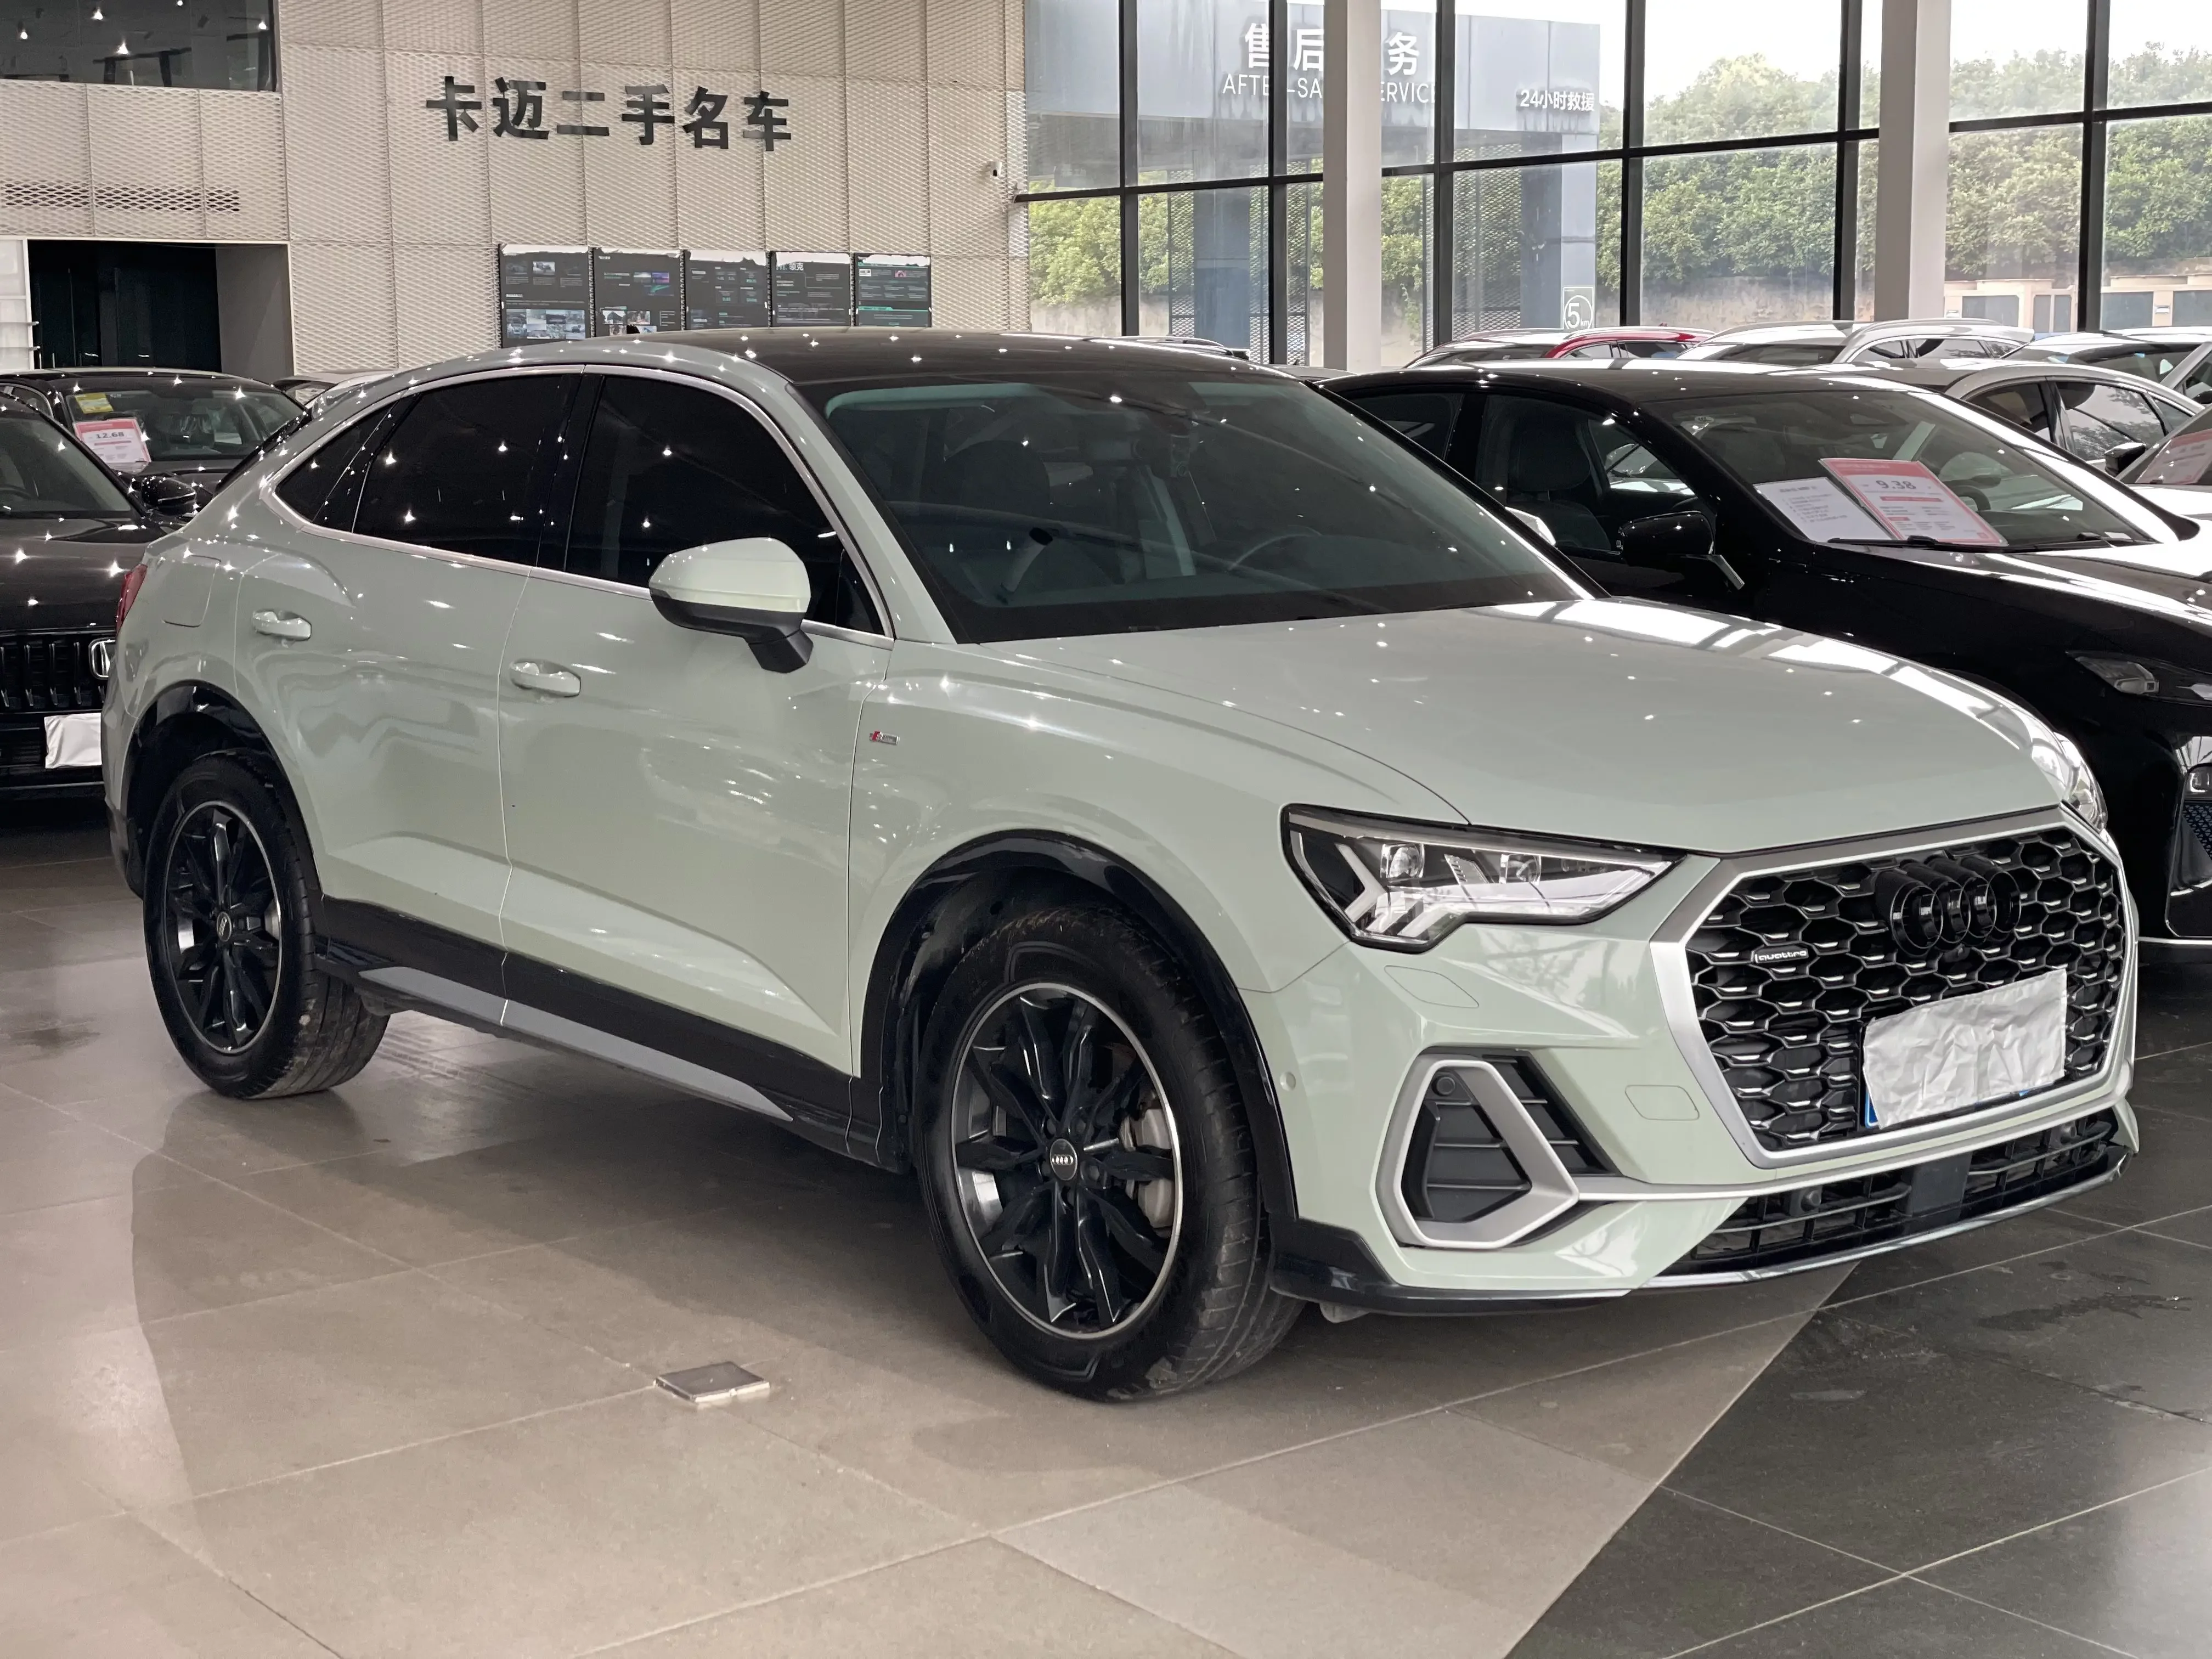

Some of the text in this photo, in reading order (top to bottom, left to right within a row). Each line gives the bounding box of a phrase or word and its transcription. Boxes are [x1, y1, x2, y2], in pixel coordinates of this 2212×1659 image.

[1245, 22, 1420, 76] 售后务
[1520, 89, 1595, 111] 24小时救援
[426, 76, 792, 151] 卡迈二手名车
[1876, 480, 1916, 489] 9.38
[1758, 950, 1807, 961] quattro
